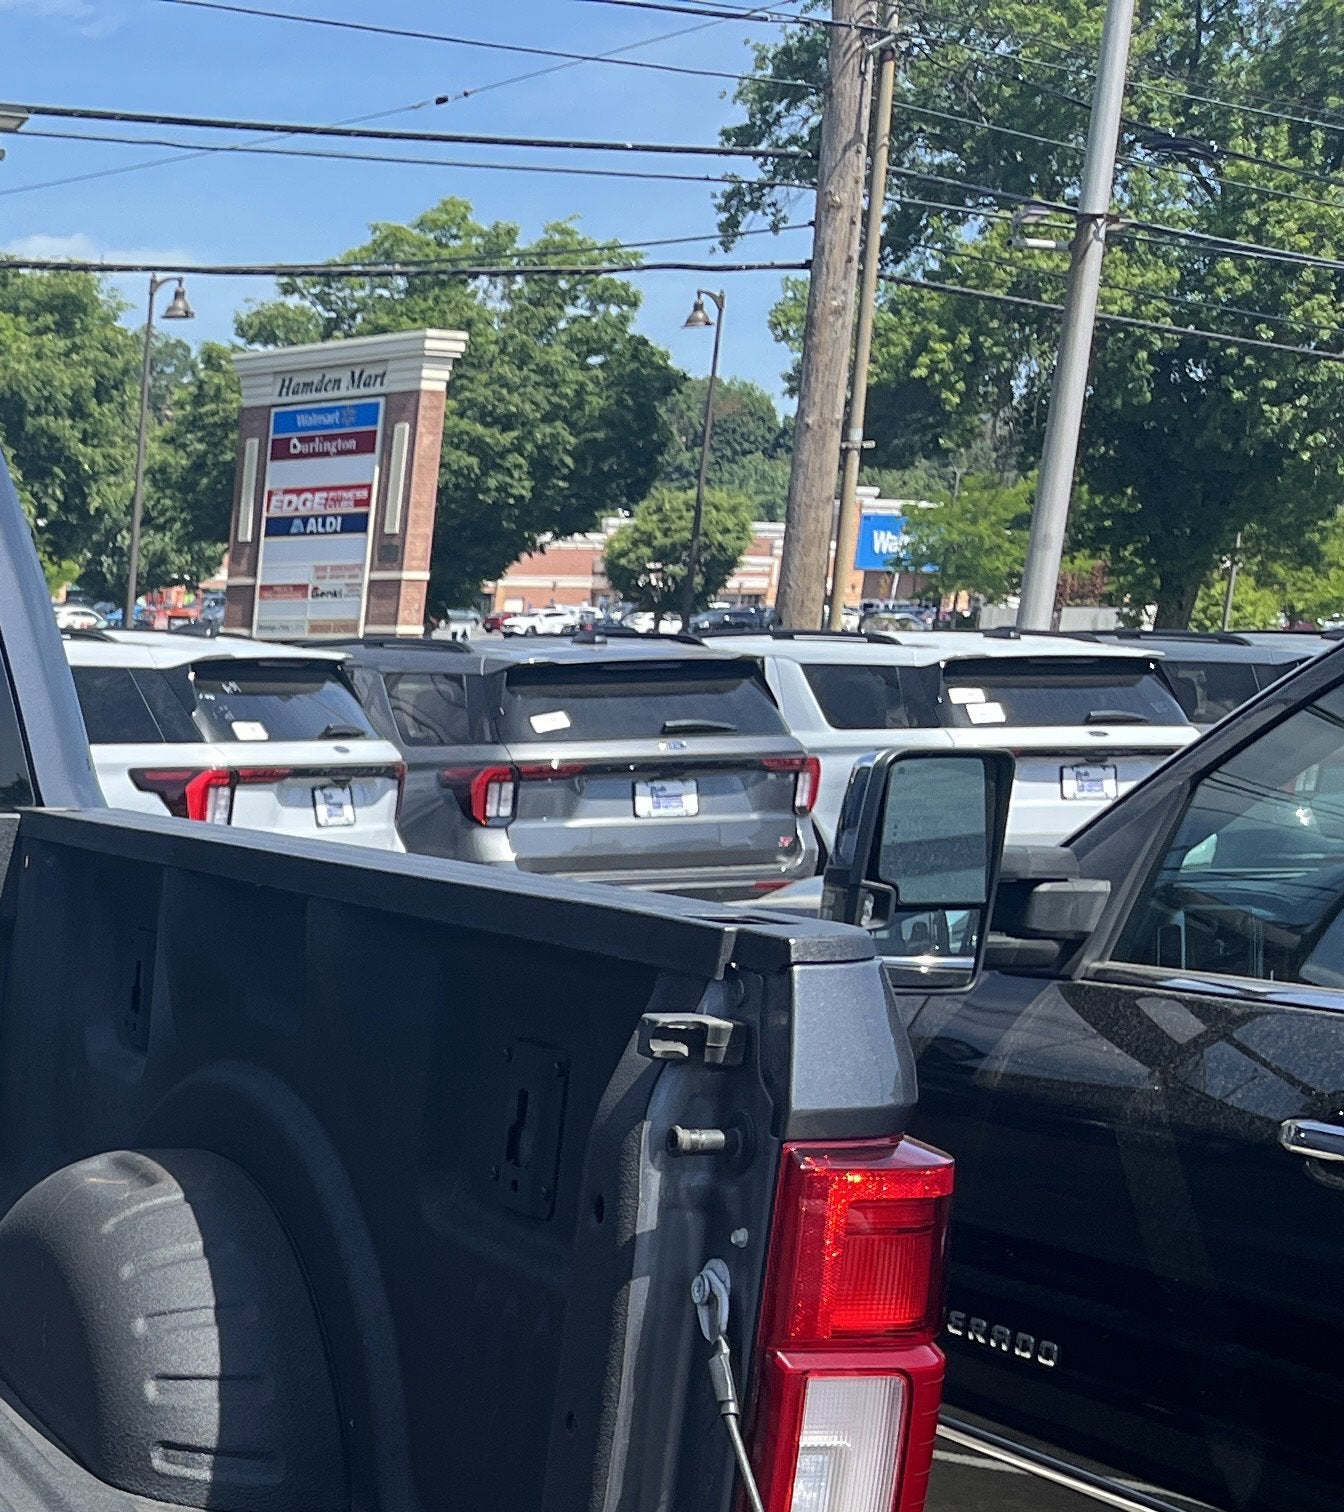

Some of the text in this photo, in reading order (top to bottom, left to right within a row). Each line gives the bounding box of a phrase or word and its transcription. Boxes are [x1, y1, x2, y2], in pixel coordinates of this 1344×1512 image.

[278, 368, 387, 397] Hamden Mart
[296, 410, 340, 428] Walmart
[289, 437, 357, 456] Burlington
[269, 492, 328, 514] EDGE
[305, 516, 343, 534] ALDI
[944, 1308, 1059, 1367] ERADO
